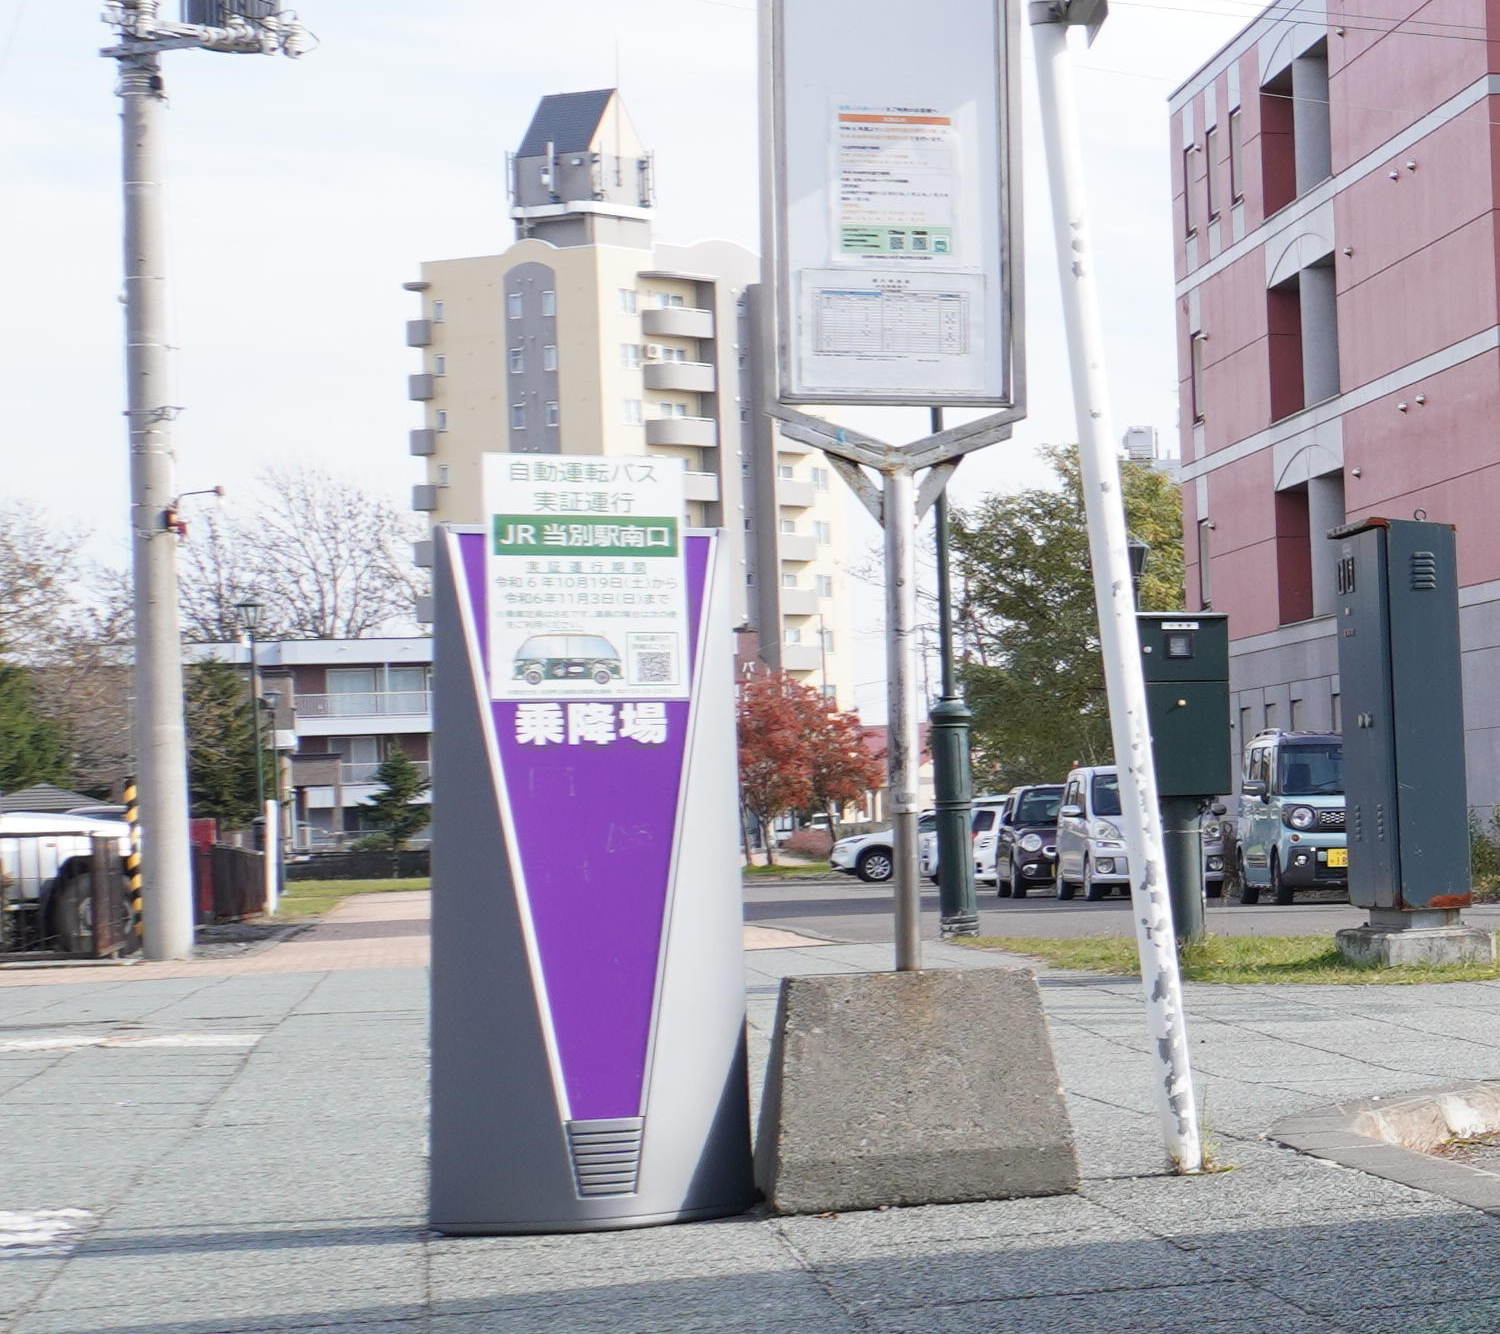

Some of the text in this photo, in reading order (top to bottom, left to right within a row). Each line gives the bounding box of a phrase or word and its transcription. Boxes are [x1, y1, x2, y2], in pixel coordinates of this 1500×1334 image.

[509, 461, 658, 484] 自動運転バス
[533, 491, 636, 514] 実証運行
[500, 523, 671, 548] JR 当別駅南口
[515, 702, 668, 746] 乗降場
